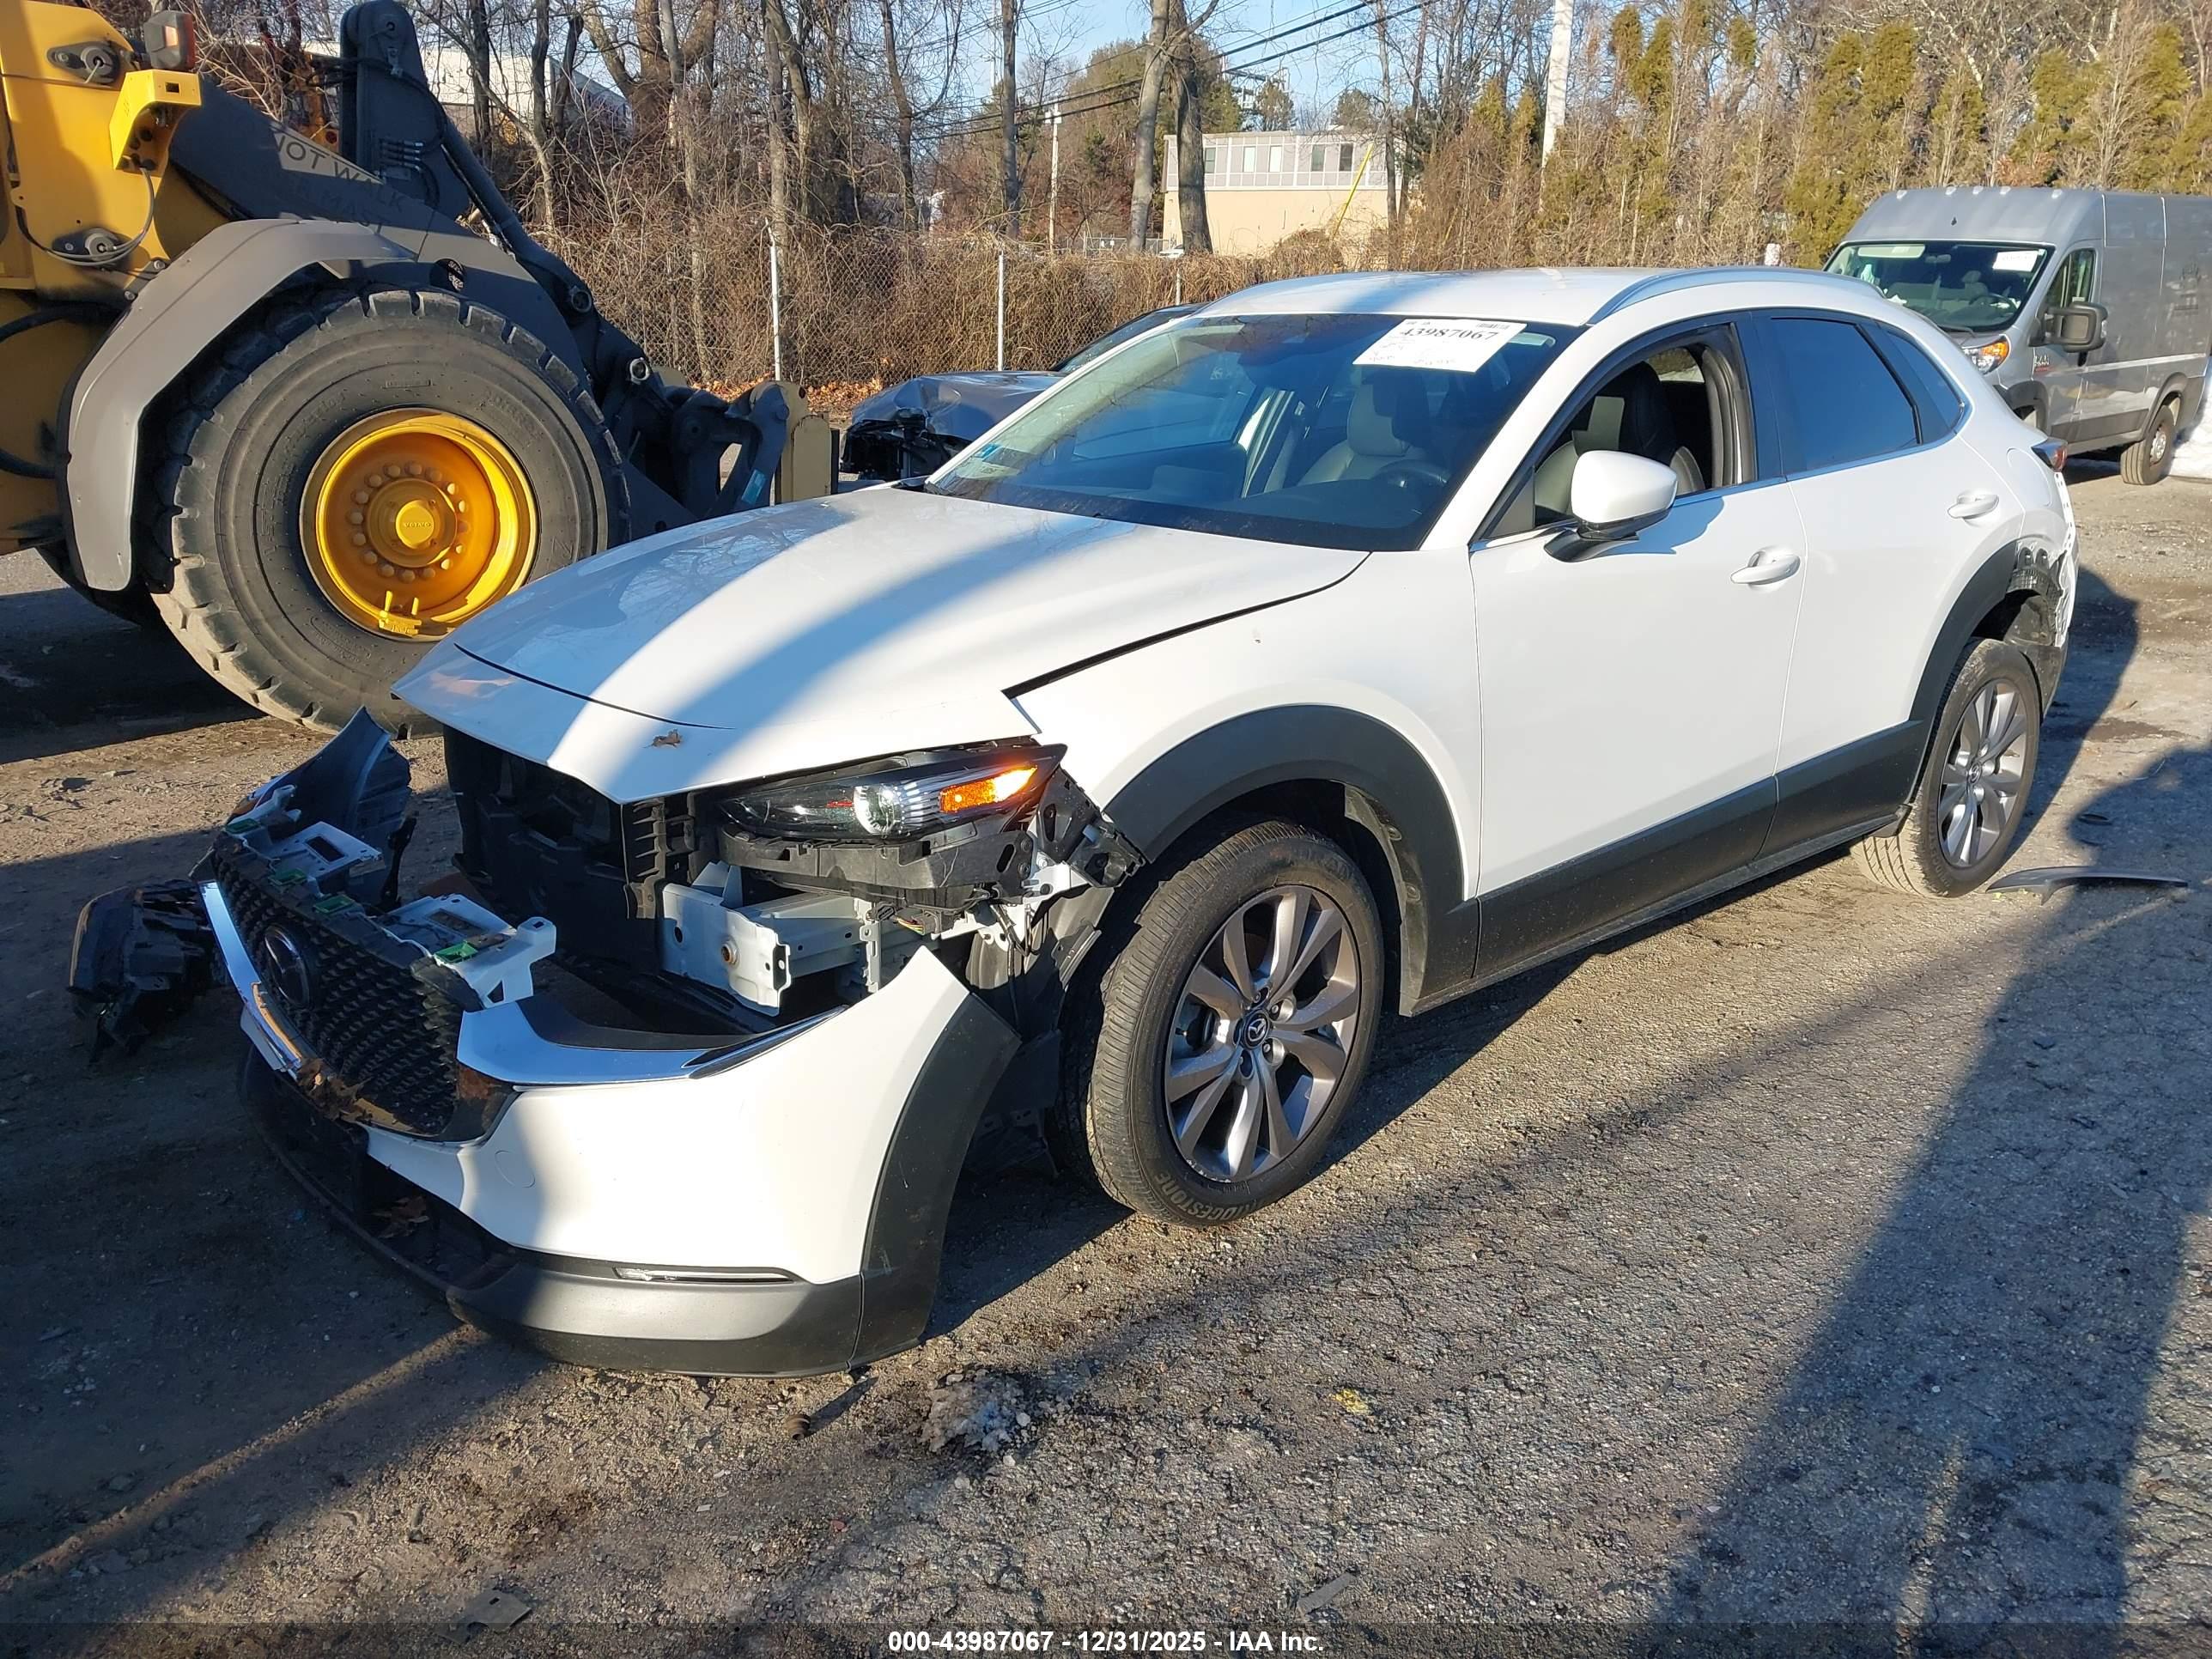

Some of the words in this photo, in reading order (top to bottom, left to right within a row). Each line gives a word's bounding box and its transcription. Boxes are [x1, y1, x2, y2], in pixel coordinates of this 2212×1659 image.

[334, 161, 405, 213] WALK
[1400, 328, 1498, 340] 43987067
[1155, 1173, 1257, 1221] IDGESTONE
